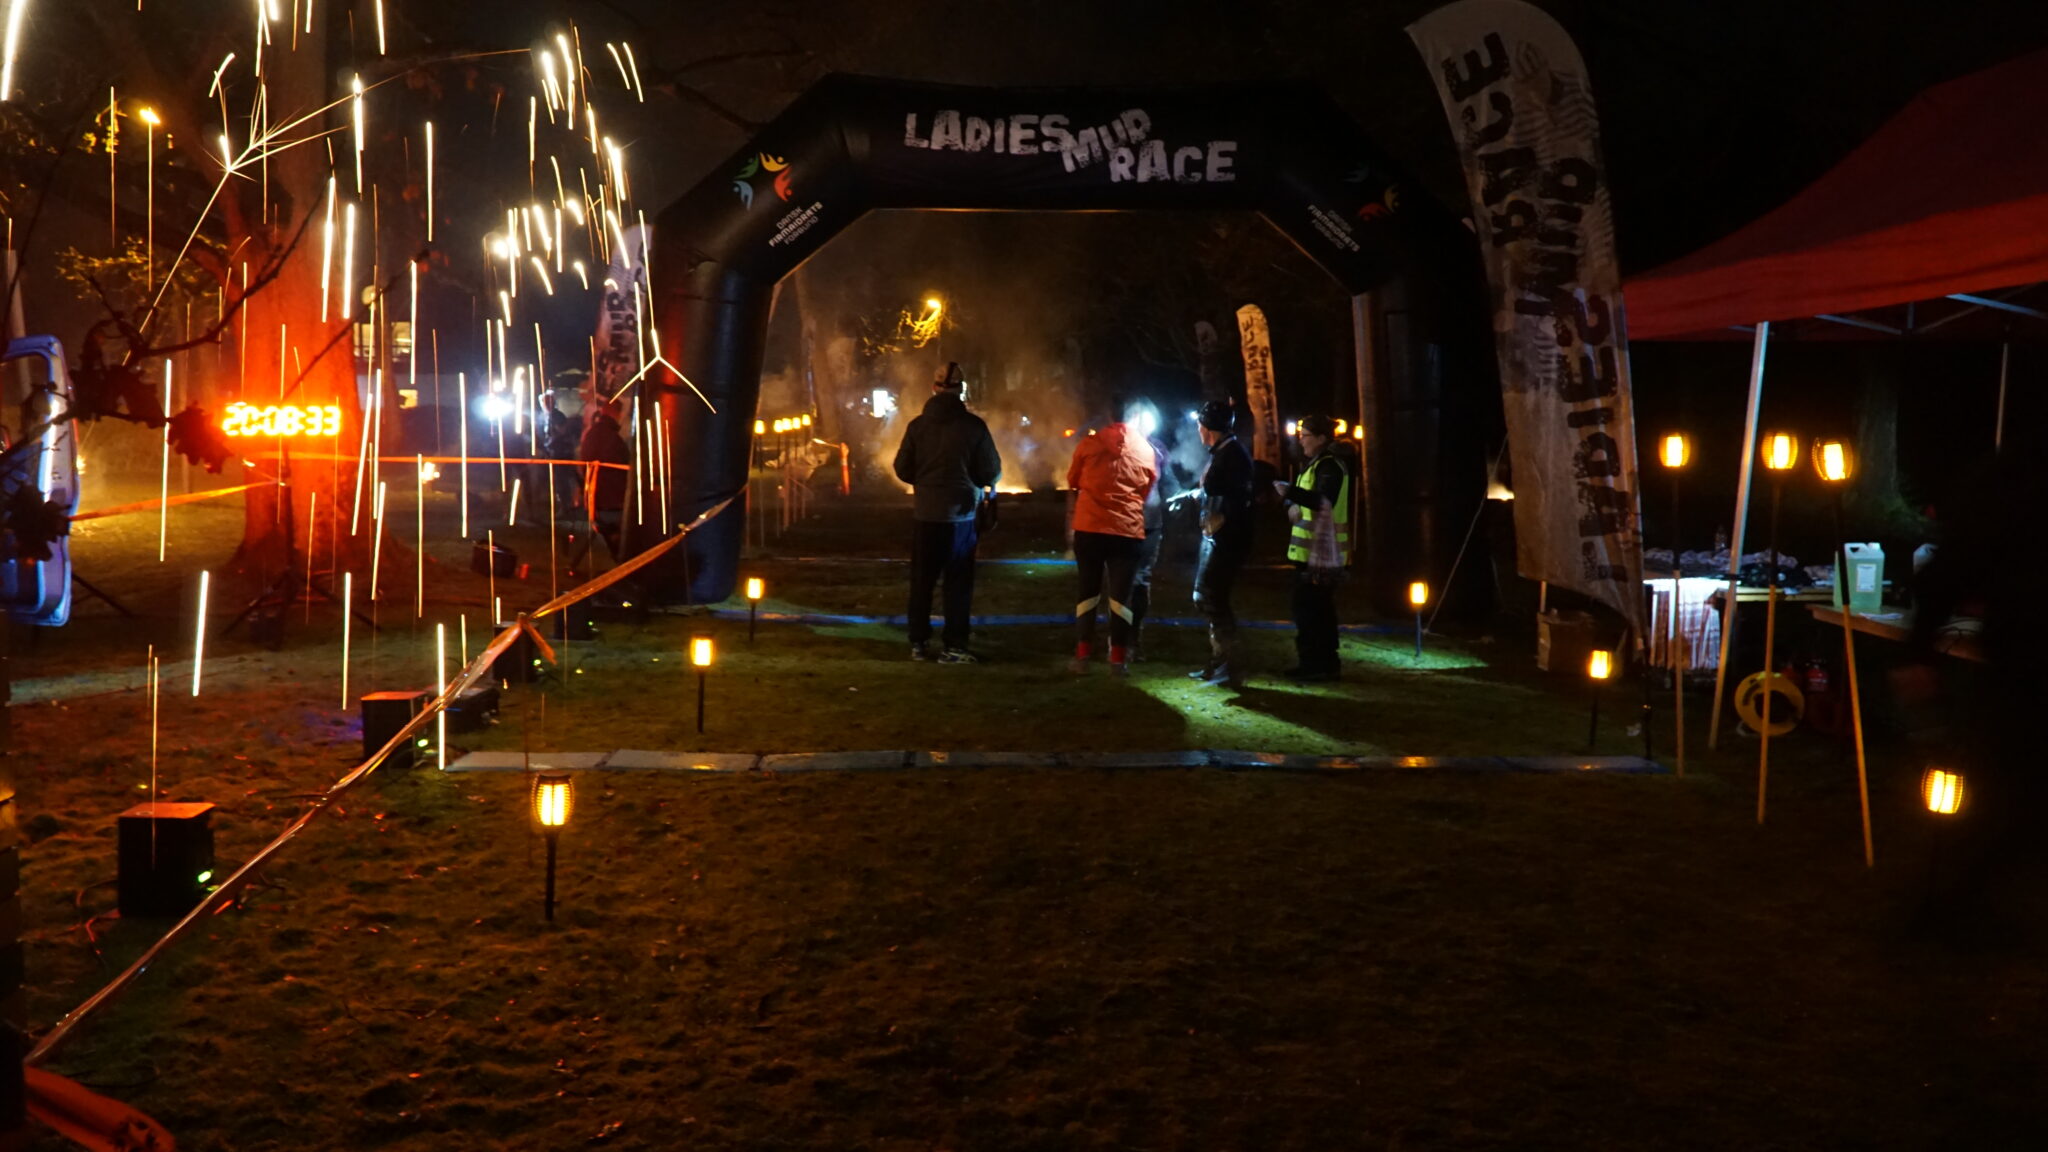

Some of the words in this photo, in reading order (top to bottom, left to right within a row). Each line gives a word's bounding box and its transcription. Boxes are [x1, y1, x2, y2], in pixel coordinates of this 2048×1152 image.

[904, 109, 1070, 154] LADIES
[1060, 107, 1153, 174] MUD
[1109, 139, 1238, 183] RACE
[222, 403, 342, 436] 20:08:33
